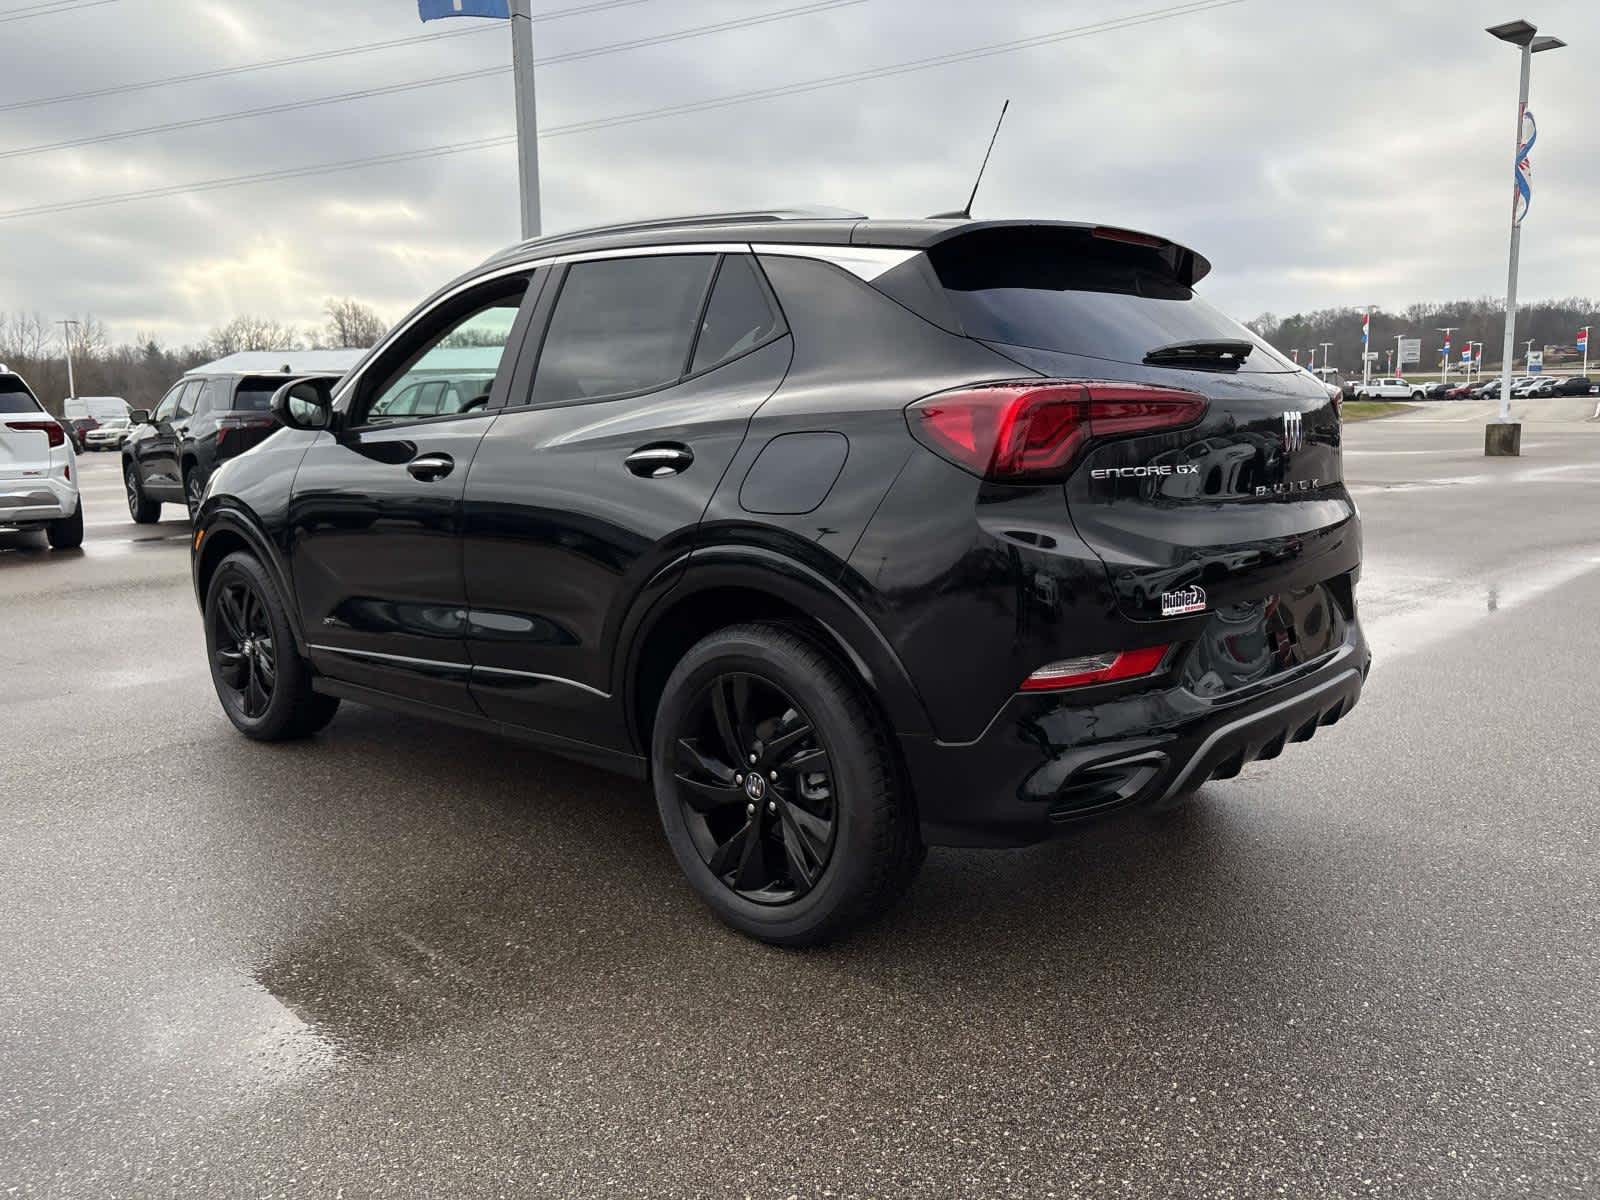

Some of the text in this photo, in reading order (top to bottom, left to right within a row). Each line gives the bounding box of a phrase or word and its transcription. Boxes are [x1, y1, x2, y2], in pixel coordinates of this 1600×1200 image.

[1090, 464, 1199, 479] ENCORE GX
[1255, 478, 1319, 496] BUICK
[1162, 591, 1196, 609] Hubler
